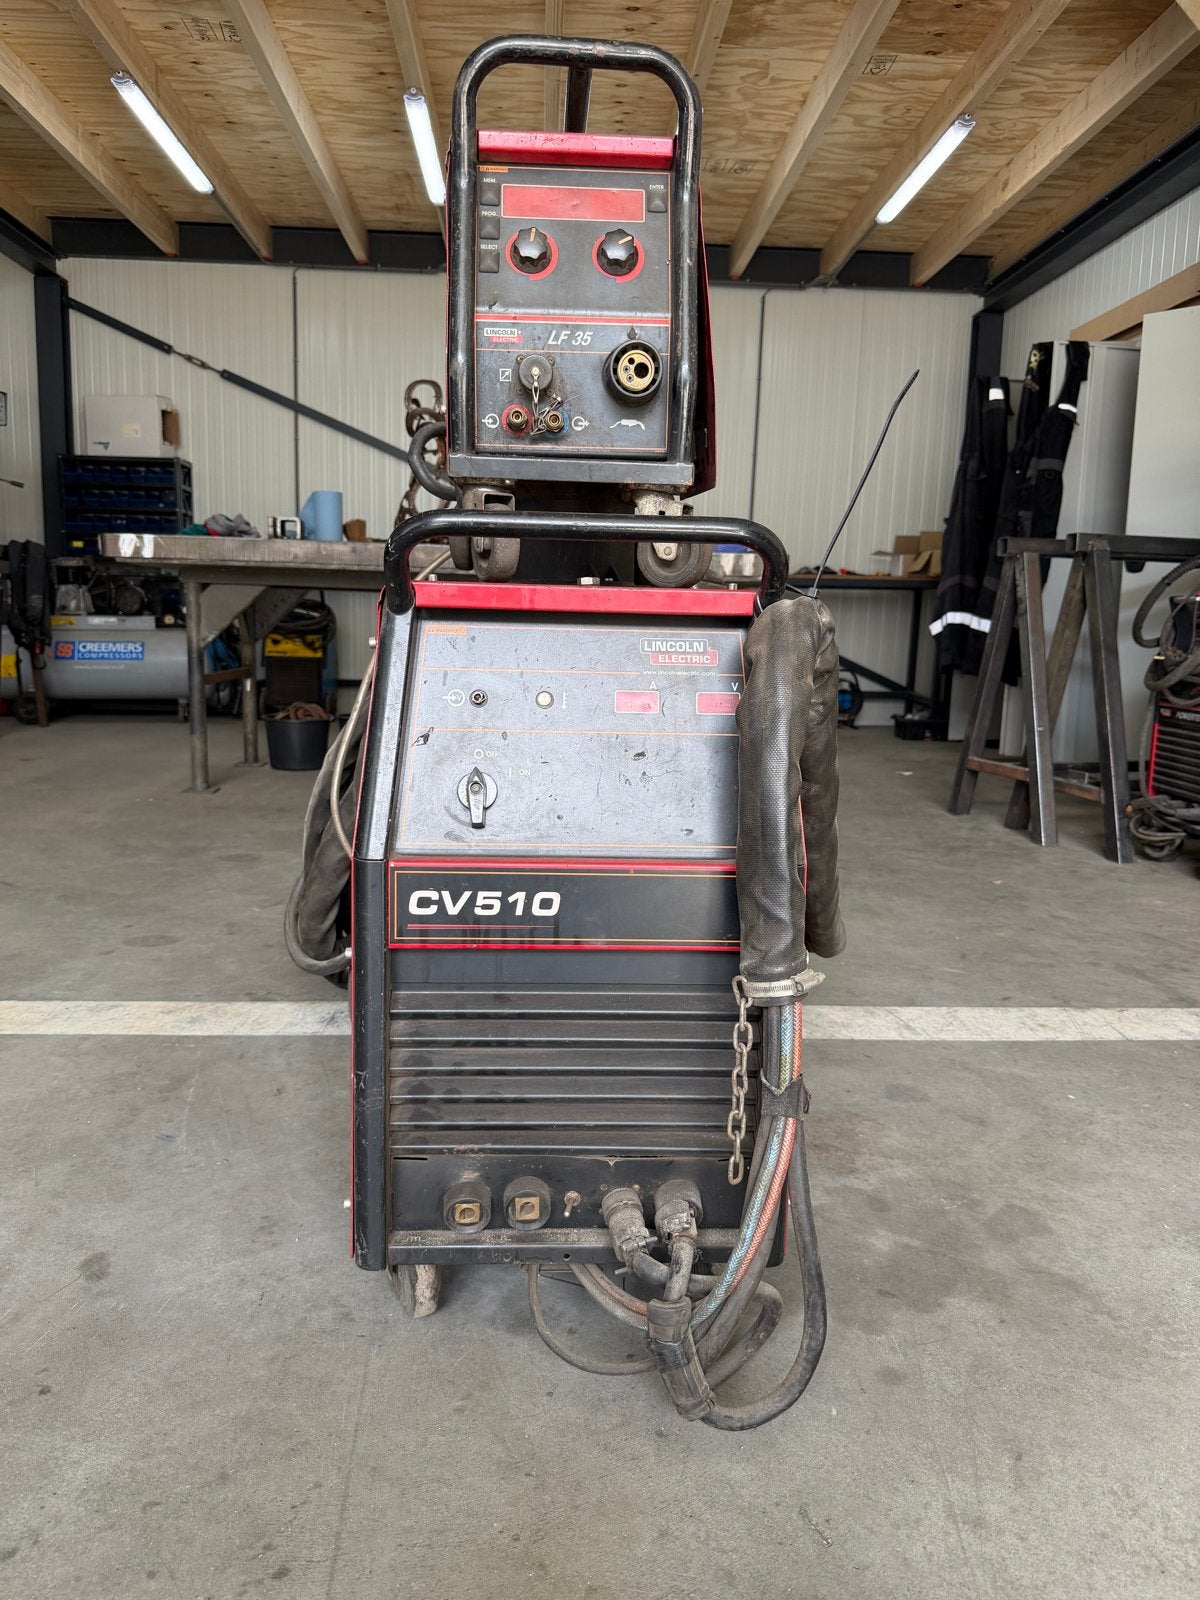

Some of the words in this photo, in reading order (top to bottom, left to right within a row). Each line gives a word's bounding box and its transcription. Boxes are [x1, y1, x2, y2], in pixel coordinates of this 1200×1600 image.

[547, 330, 570, 345] LF
[571, 331, 593, 345] 35
[79, 642, 143, 652] CREEMERS
[644, 641, 704, 653] LINCOLN
[658, 655, 711, 664] ELECTRIC
[643, 669, 716, 677] www.lincolnelectric.com
[649, 681, 658, 690] A
[731, 682, 739, 691] V
[519, 768, 531, 776] ON
[408, 890, 561, 916] CV510
